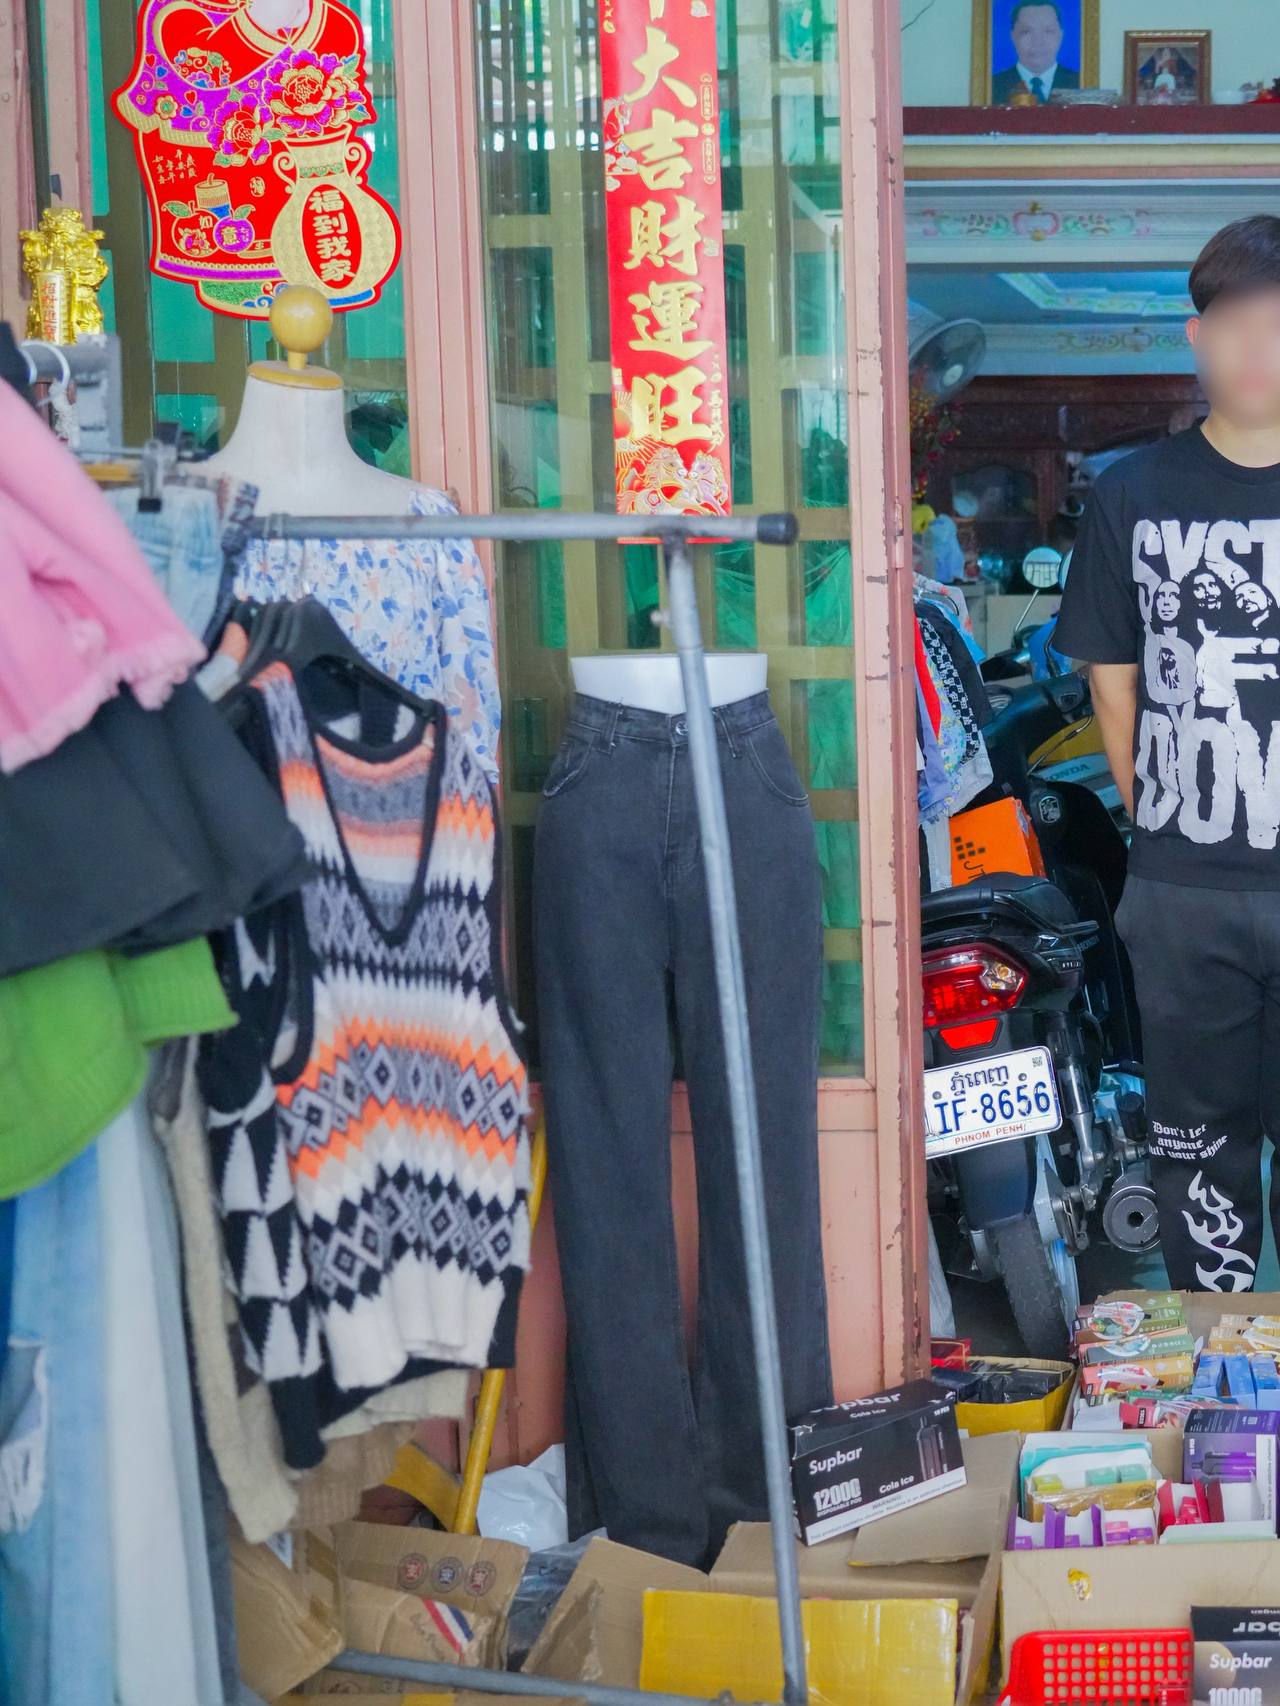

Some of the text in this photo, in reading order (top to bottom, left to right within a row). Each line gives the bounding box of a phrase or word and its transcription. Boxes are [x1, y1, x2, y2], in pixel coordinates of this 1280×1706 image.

[622, 0, 716, 443] 大吉財運旺
[308, 190, 356, 282] 福到我家
[1050, 764, 1090, 781] ONDA
[954, 1124, 1025, 1145] PHNOM PENH
[1152, 1120, 1186, 1139] Don't
[1157, 1137, 1205, 1151] anyone
[809, 1447, 863, 1475] Supbar
[813, 1478, 862, 1511] 12000
[879, 1475, 914, 1494] Cola Ice
[1209, 1652, 1272, 1671] Supbar
